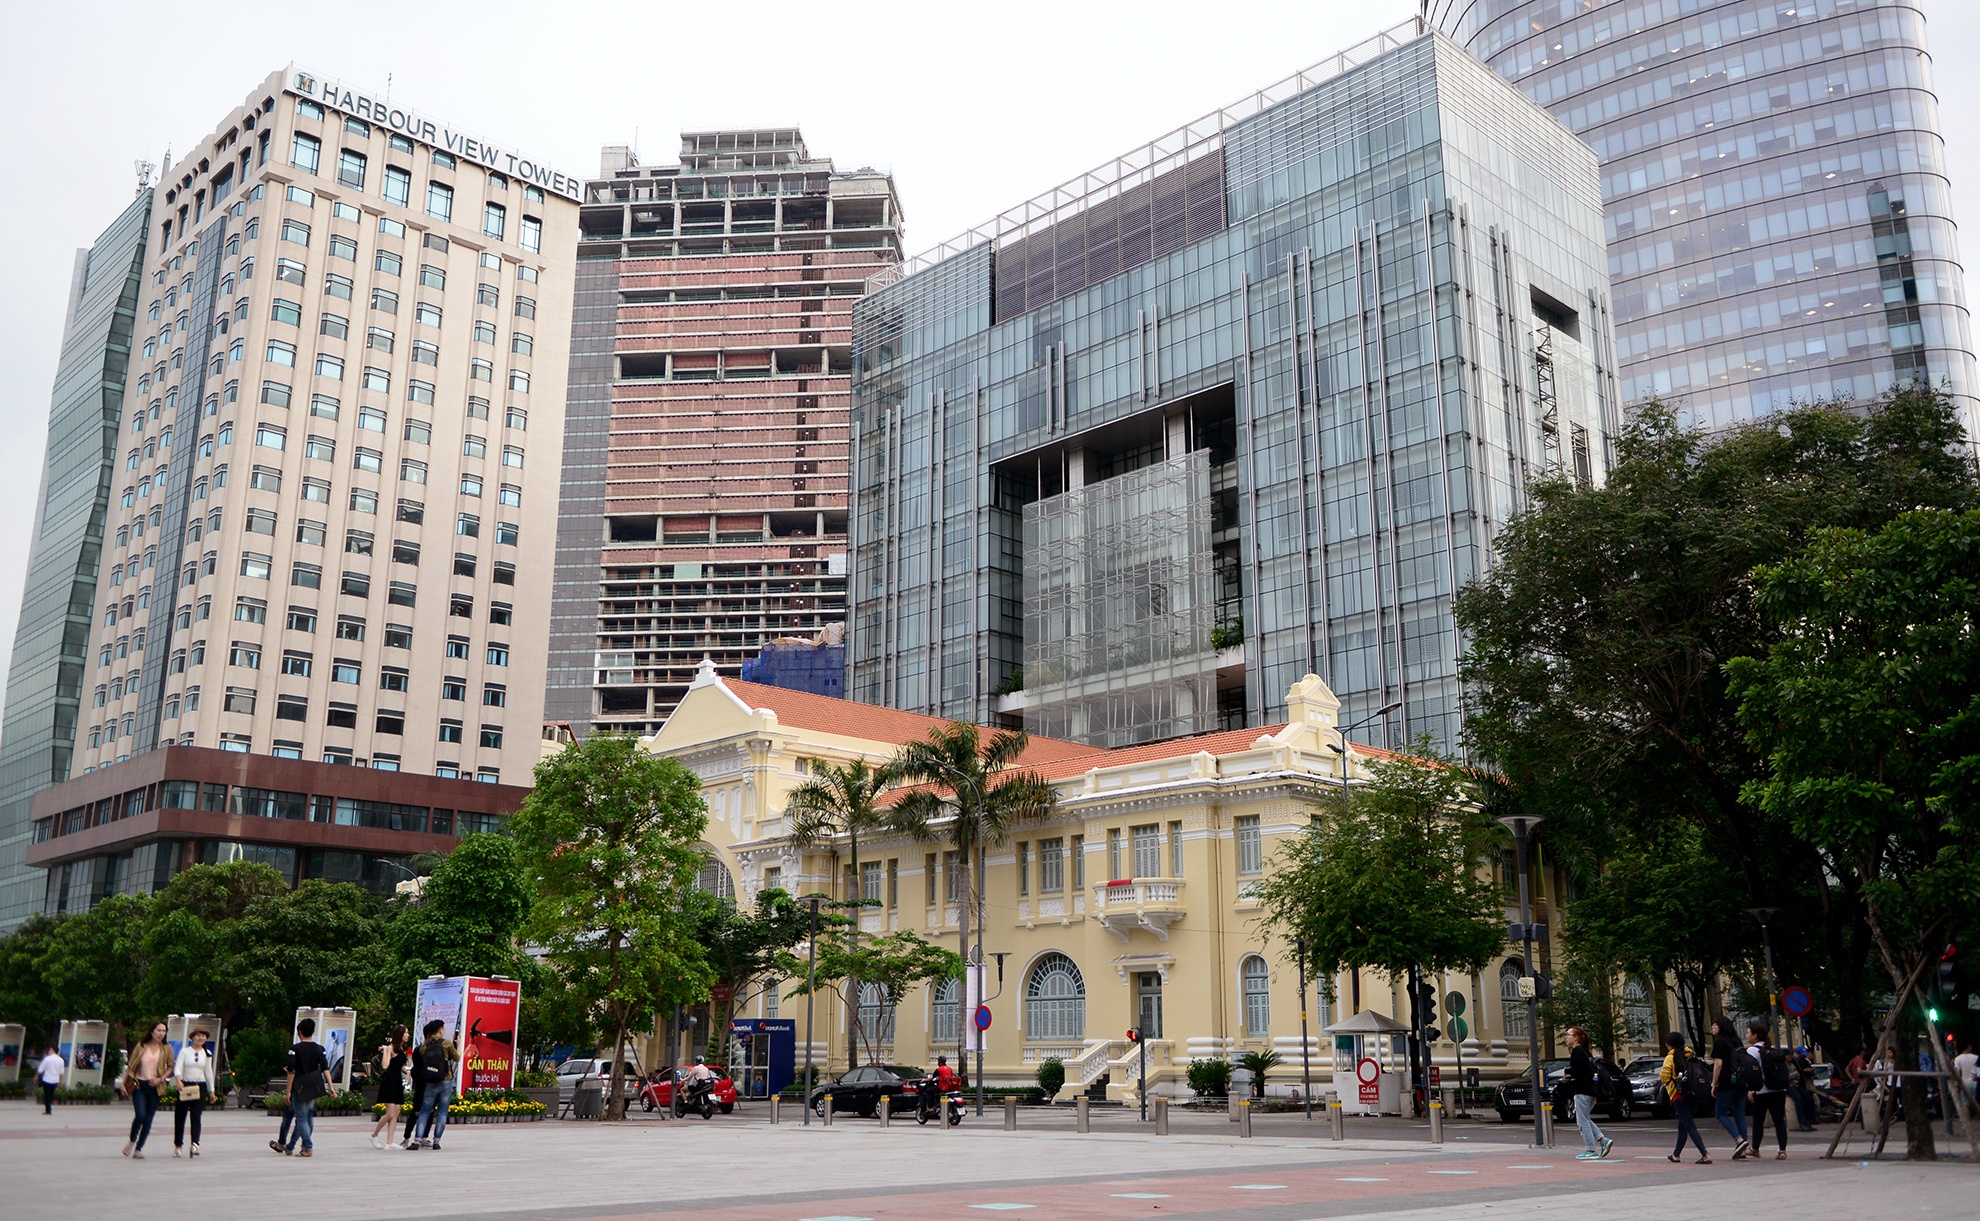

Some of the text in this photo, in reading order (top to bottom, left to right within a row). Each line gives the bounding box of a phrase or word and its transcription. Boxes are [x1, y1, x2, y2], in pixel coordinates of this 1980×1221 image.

[322, 82, 579, 199] HARBOUR VIEW TOWER
[487, 1057, 509, 1073] THẬN
